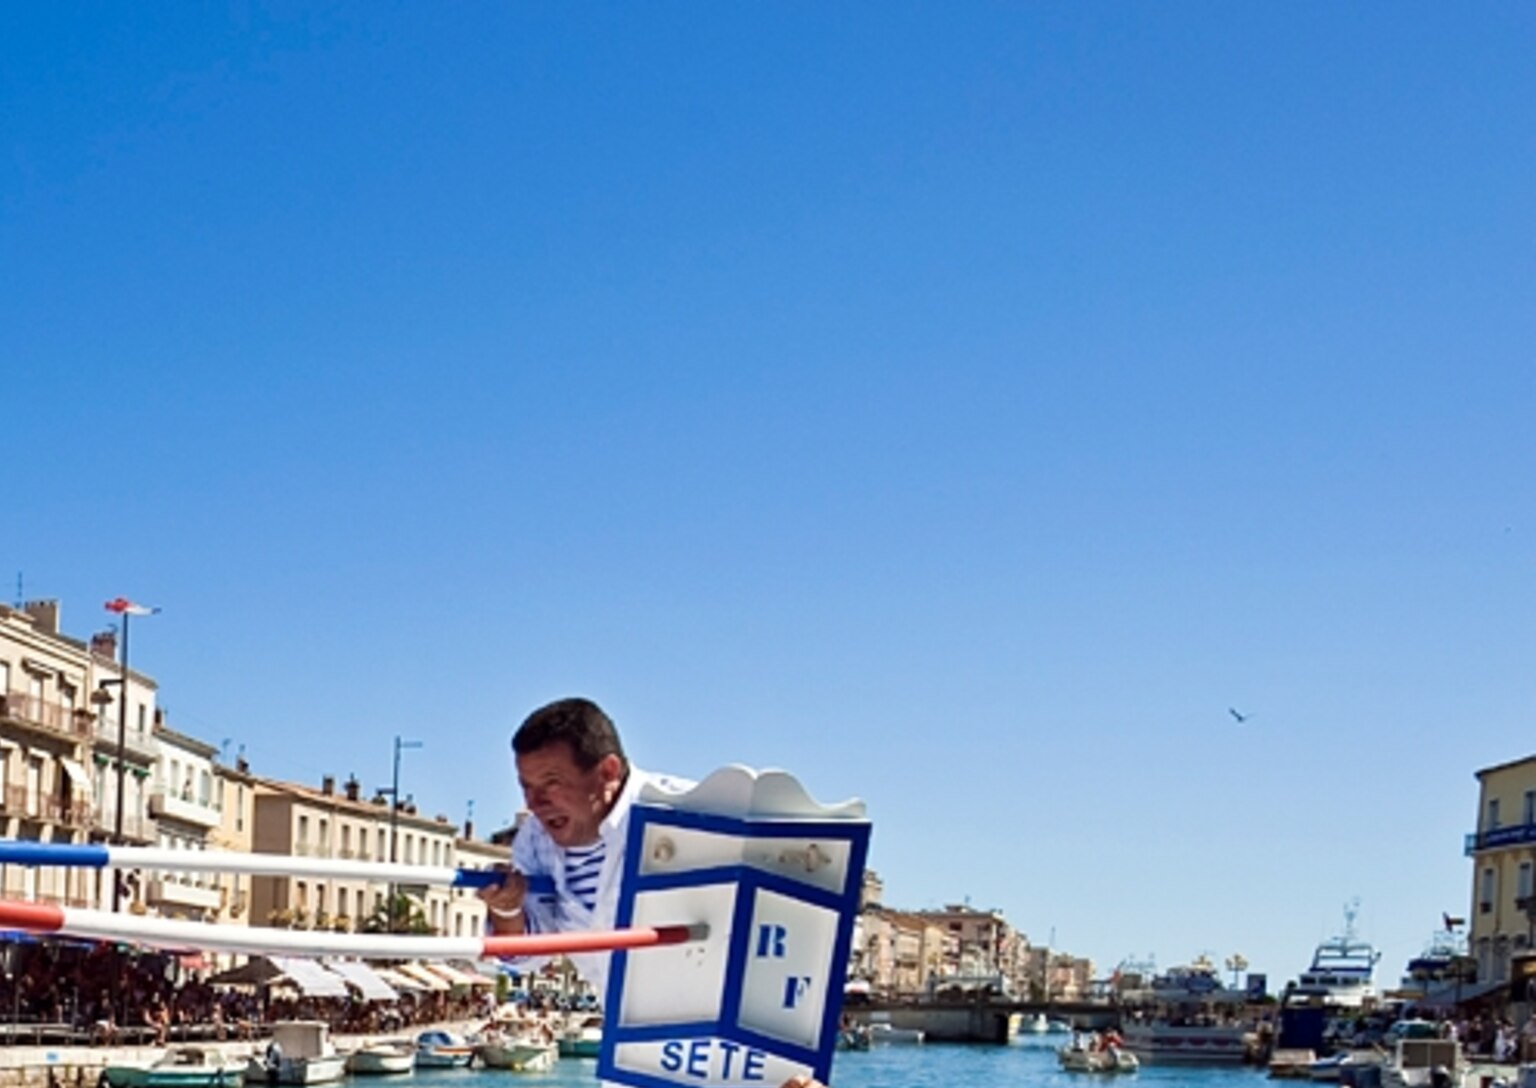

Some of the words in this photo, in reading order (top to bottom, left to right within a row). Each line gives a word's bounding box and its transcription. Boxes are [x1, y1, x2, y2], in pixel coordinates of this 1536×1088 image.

[756, 925, 786, 957] R
[783, 977, 811, 1008] F
[661, 1040, 767, 1081] SETE
